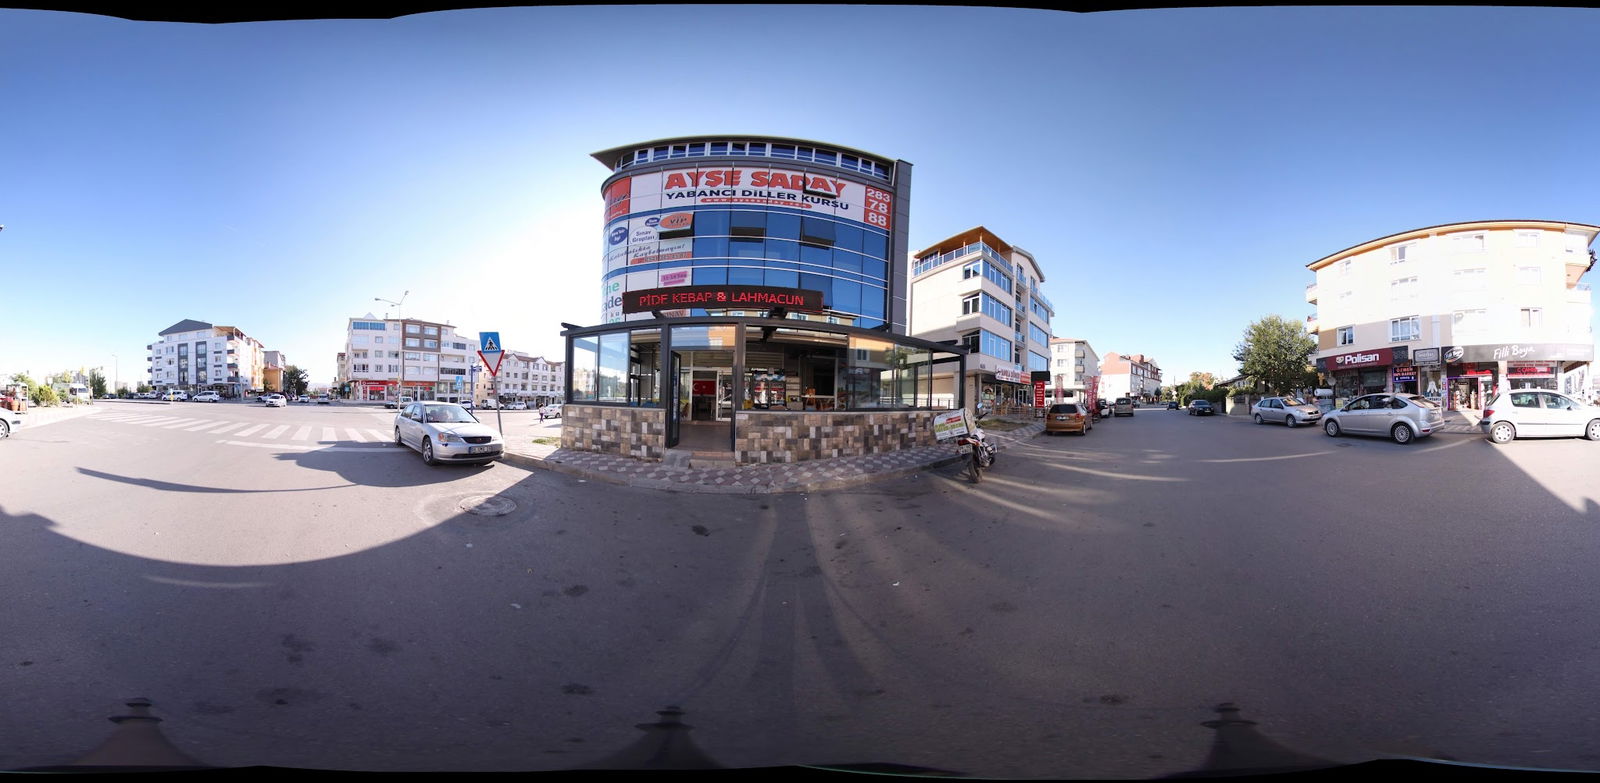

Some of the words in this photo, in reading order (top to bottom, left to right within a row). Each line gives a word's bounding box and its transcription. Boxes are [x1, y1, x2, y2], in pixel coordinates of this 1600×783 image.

[664, 170, 742, 190] AYŞE
[751, 171, 847, 198] SADAY
[666, 189, 737, 200] YABANCI
[741, 189, 797, 201] DİLLER
[801, 194, 850, 211] KURSU
[867, 188, 891, 203] 283
[868, 200, 888, 214] 78
[868, 213, 888, 227] 88
[672, 292, 712, 303] KEBAP
[716, 291, 727, 302] &
[731, 293, 804, 306] LAHMACUN
[1344, 353, 1380, 365] Polisan
[1493, 346, 1510, 360] Filli
[1511, 344, 1536, 359] Boya
